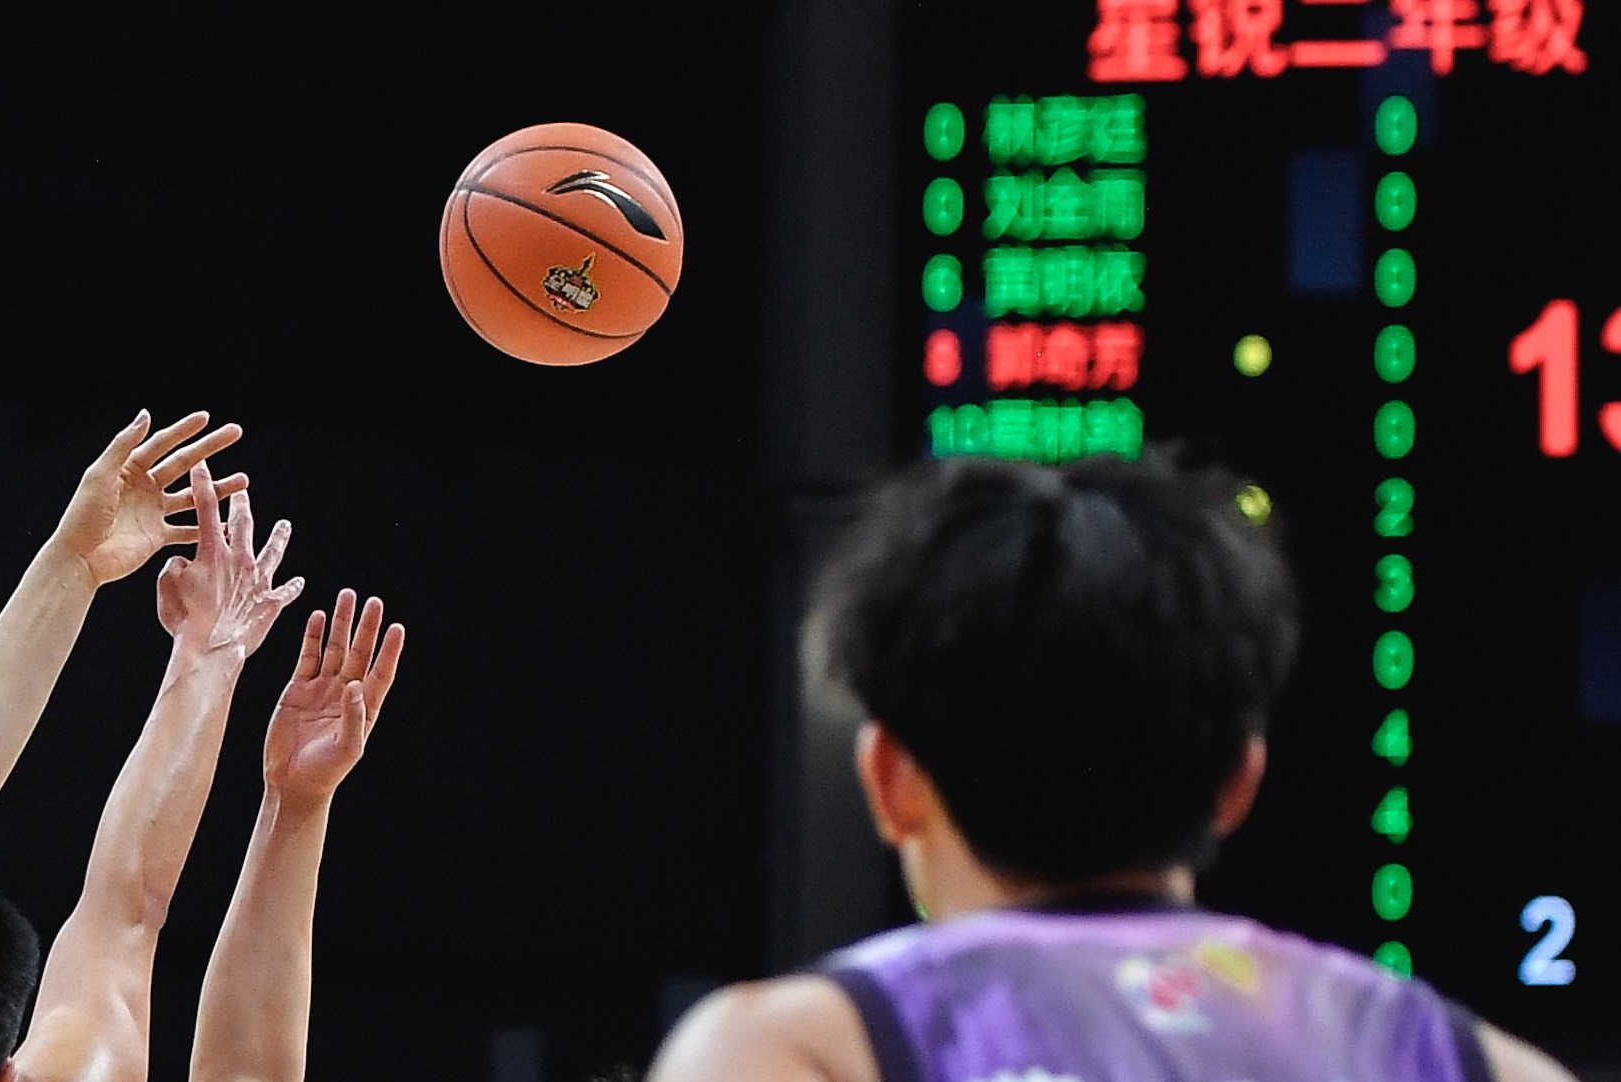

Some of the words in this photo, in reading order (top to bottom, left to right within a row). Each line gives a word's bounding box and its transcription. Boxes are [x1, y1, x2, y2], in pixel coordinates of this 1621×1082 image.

[924, 103, 965, 161] 0
[1376, 95, 1416, 155] 0
[923, 177, 964, 236] 0
[1375, 172, 1415, 231] 0
[1375, 248, 1415, 307] 0
[1374, 324, 1415, 382] 0
[1374, 400, 1415, 459] 0
[1374, 477, 1414, 537] 2
[1374, 554, 1413, 613] 3
[1373, 630, 1413, 690] 0
[1372, 709, 1412, 766] 4
[1371, 786, 1411, 844] 4
[1372, 864, 1412, 921] 0
[1518, 896, 1577, 986] 2
